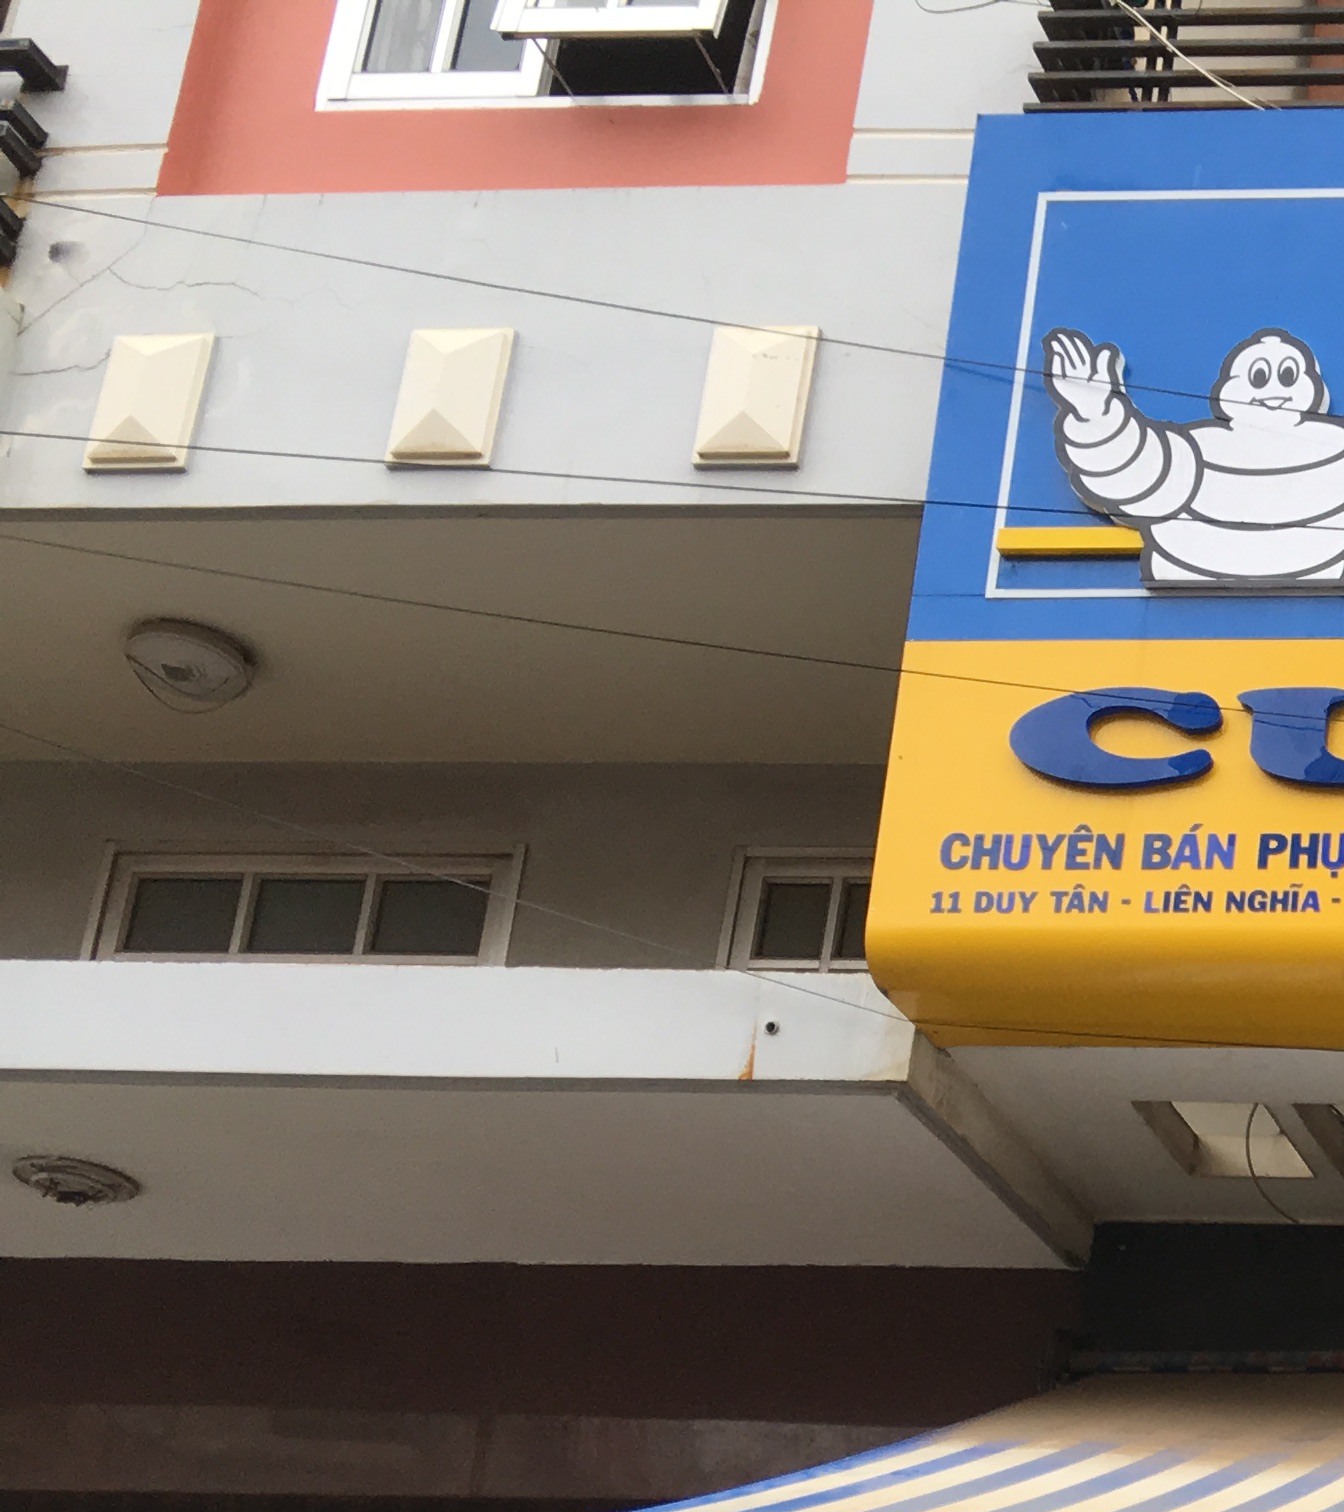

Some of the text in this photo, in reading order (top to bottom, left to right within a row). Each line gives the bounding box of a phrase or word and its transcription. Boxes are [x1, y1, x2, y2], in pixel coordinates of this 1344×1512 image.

[939, 823, 1126, 871] CHUYÊN
[1140, 823, 1237, 871] BÁN
[930, 891, 962, 914] 11
[973, 890, 1039, 914] DUY
[1050, 883, 1109, 914] TÂN
[1144, 884, 1213, 914] LIÊN
[1225, 883, 1321, 914] NGHĨA
